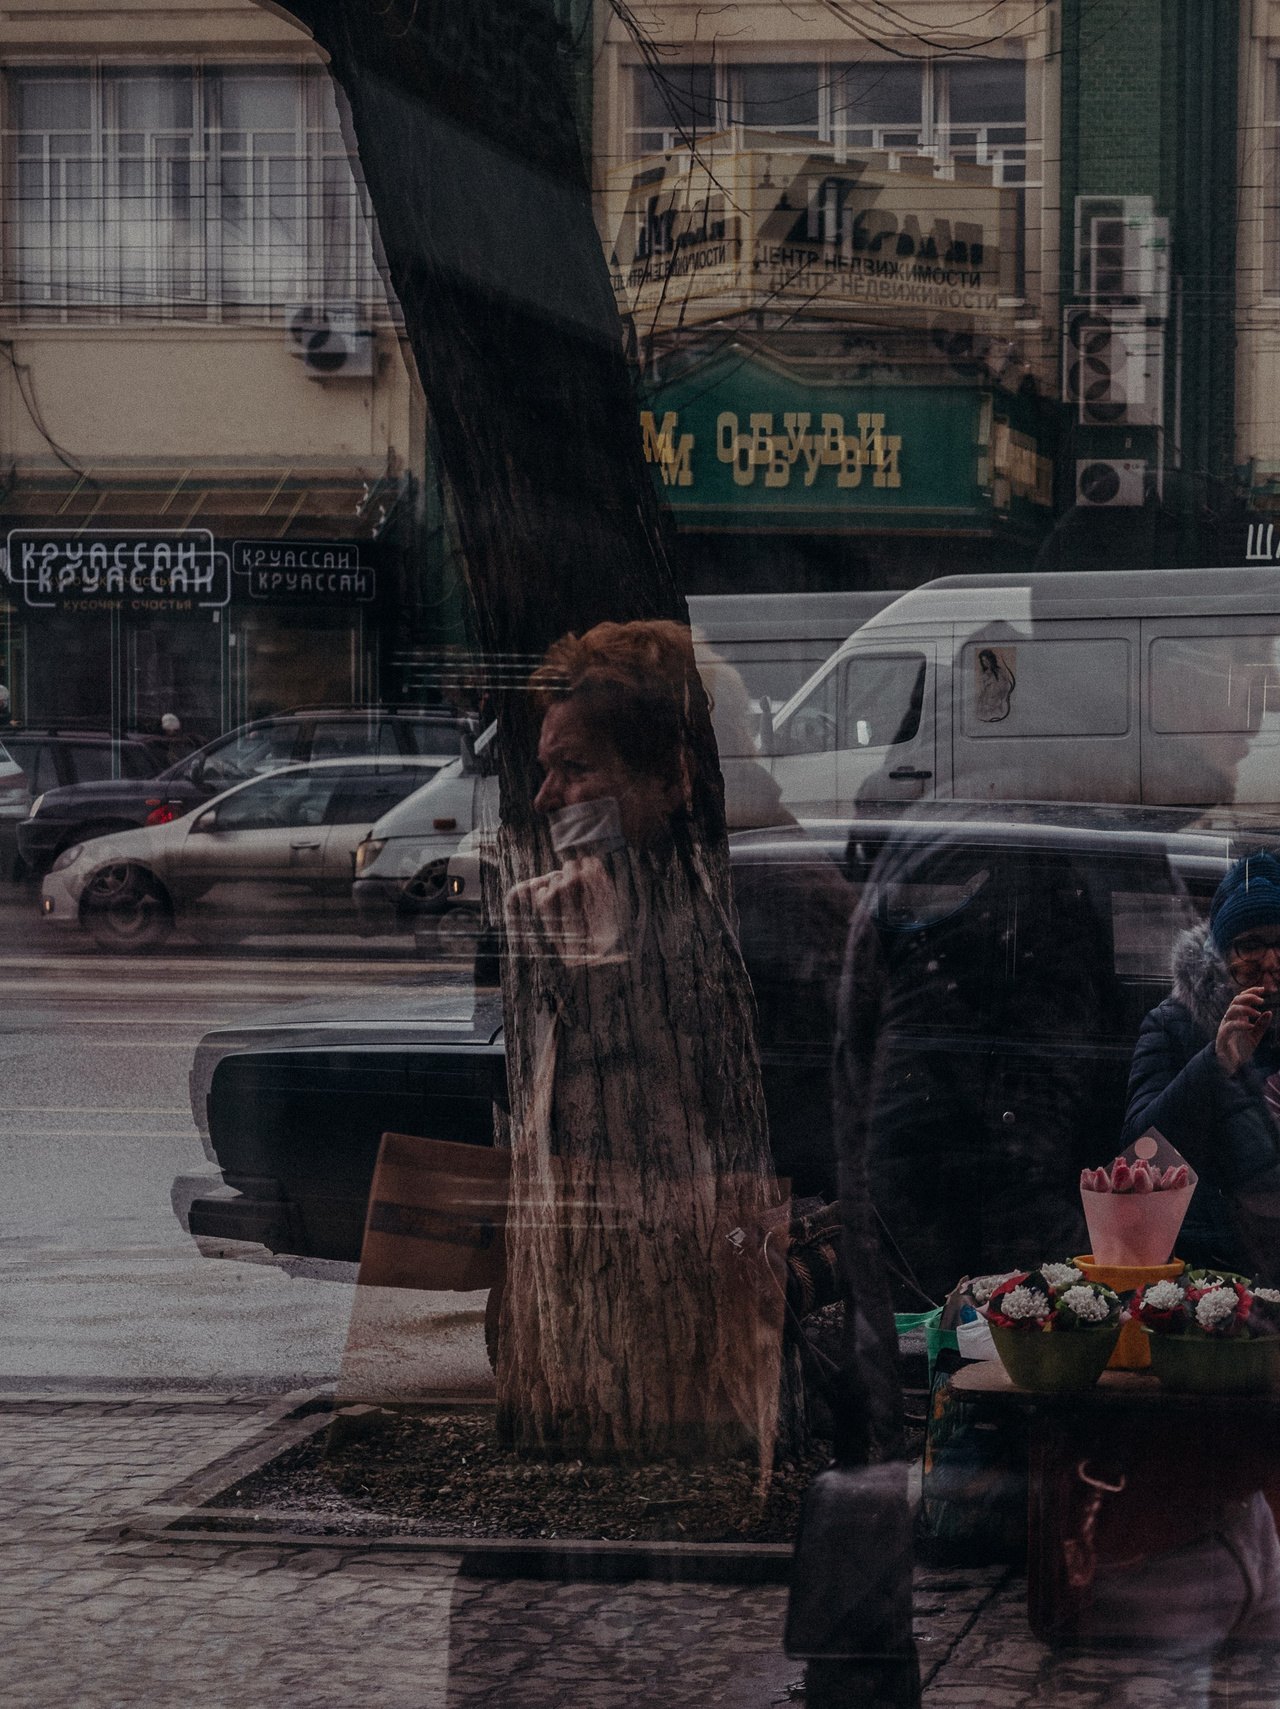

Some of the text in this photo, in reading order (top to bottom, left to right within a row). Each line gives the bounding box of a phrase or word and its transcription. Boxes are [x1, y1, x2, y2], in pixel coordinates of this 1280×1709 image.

[756, 245, 982, 289] ЦЕНТР НЕДВИЖИМОСТИ
[717, 411, 885, 465] ОБУВИ
[733, 433, 902, 488] ОБУВИ
[21, 542, 196, 570] КРУАССАН
[243, 549, 350, 568] КРУАССАН
[38, 565, 213, 593] КРУАССАН
[259, 572, 366, 592] КРУАССАН
[63, 599, 192, 612] кусочек счастья
